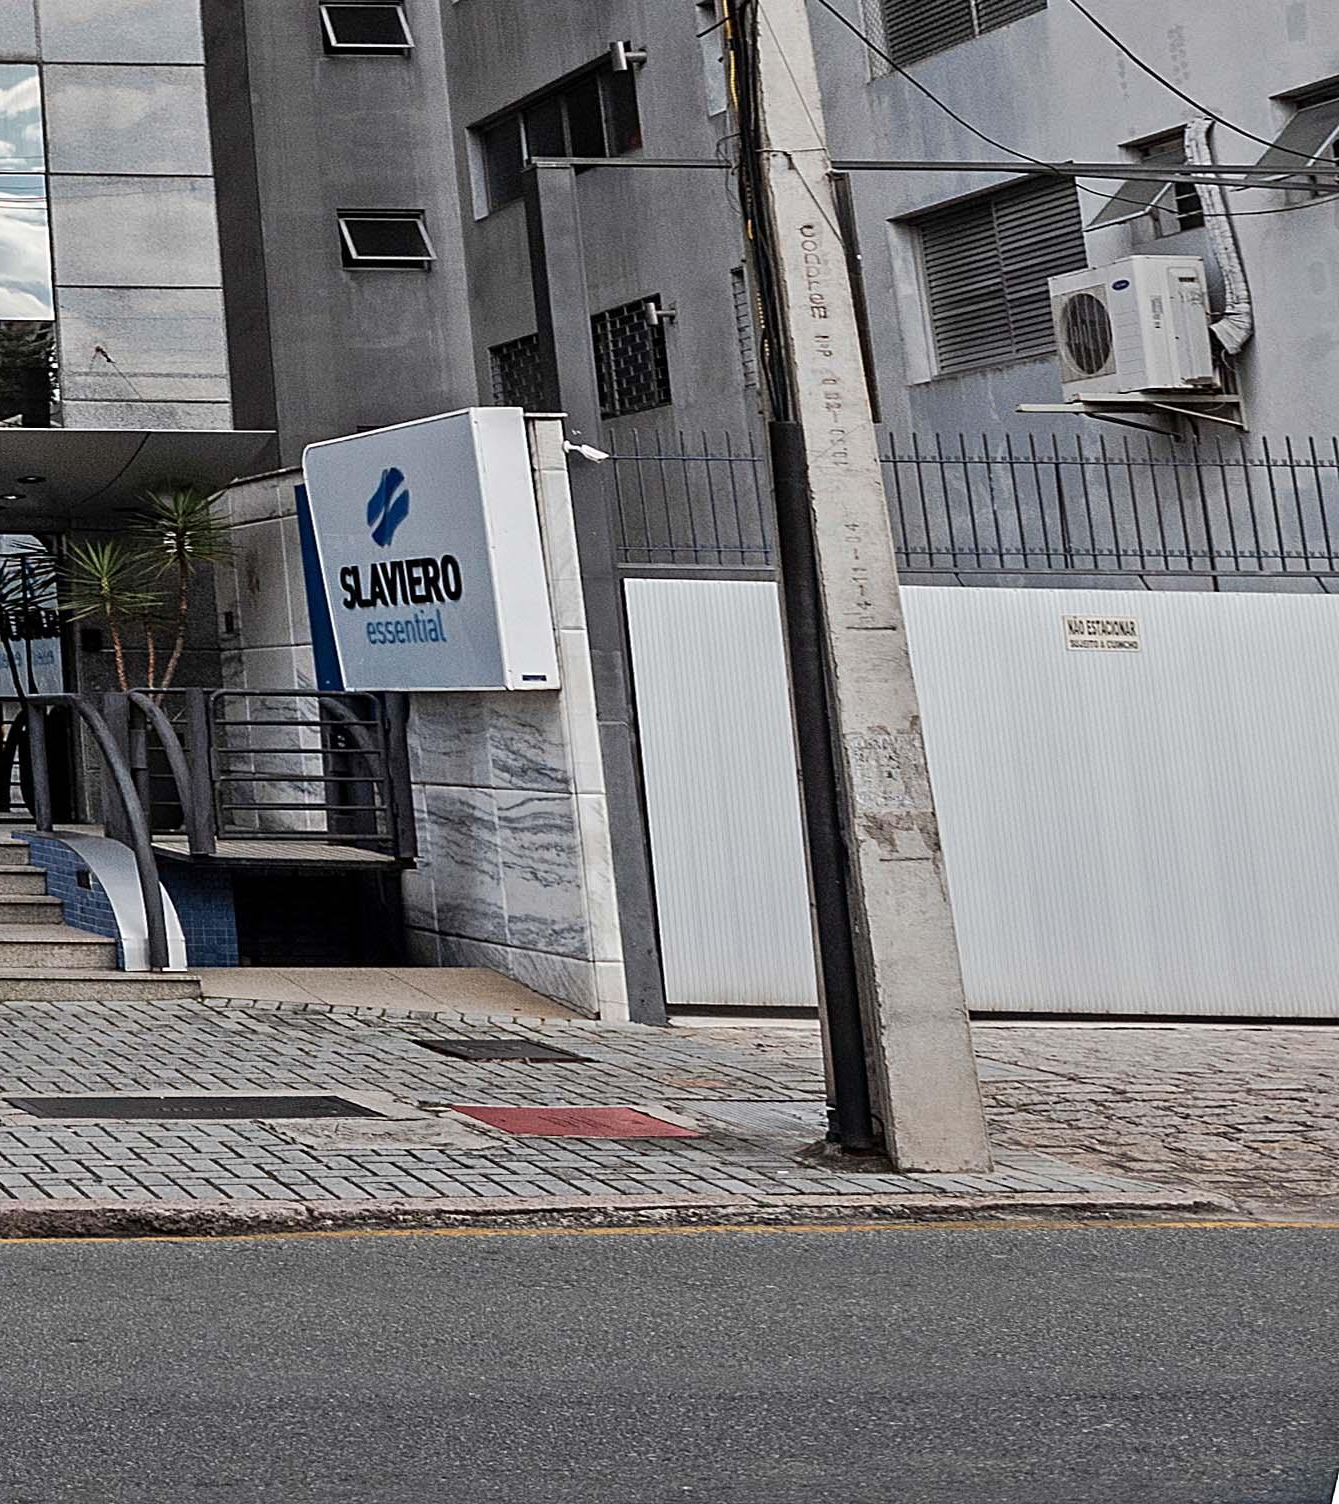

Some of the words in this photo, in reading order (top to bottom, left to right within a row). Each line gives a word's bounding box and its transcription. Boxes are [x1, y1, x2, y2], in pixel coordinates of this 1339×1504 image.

[340, 554, 463, 610] SLAVIERO
[366, 609, 447, 644] essential
[1086, 619, 1137, 636] ESTACIONAR
